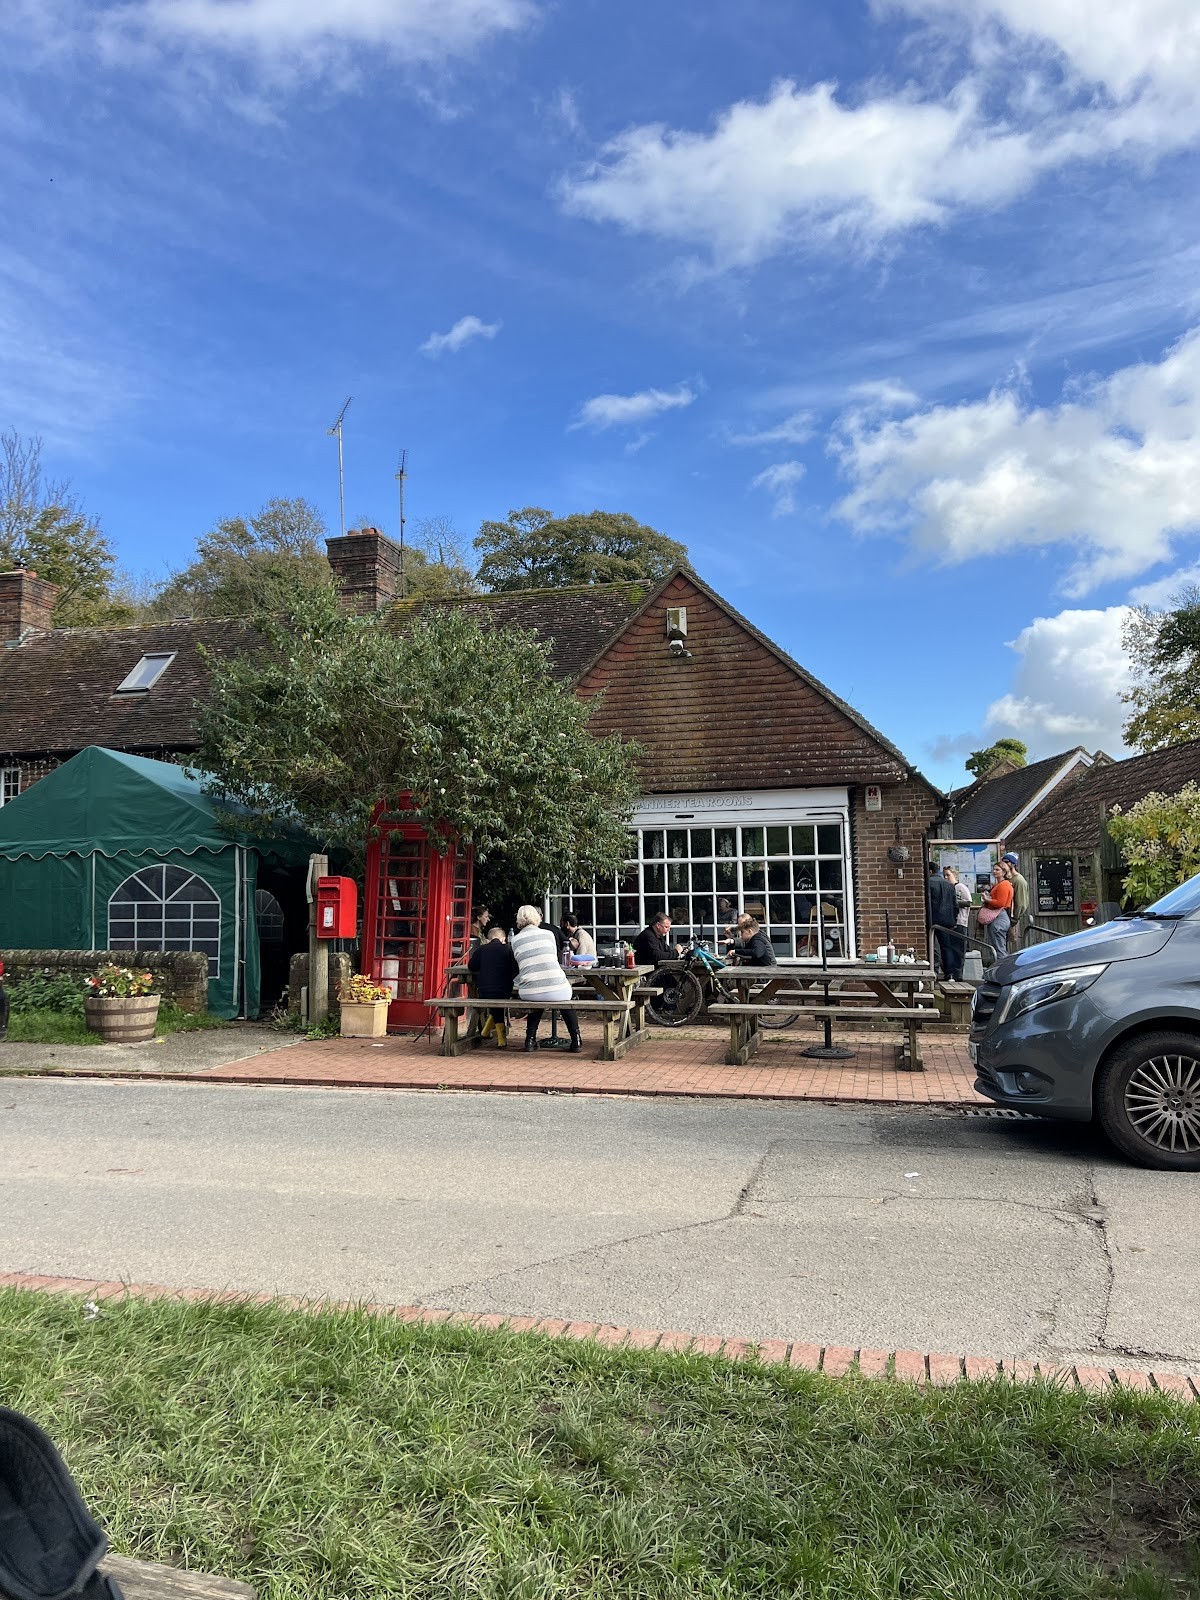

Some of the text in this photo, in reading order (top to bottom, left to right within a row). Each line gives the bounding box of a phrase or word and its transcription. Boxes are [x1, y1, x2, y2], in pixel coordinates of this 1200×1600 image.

[635, 795, 753, 810] ANMER TEA ROOMS
